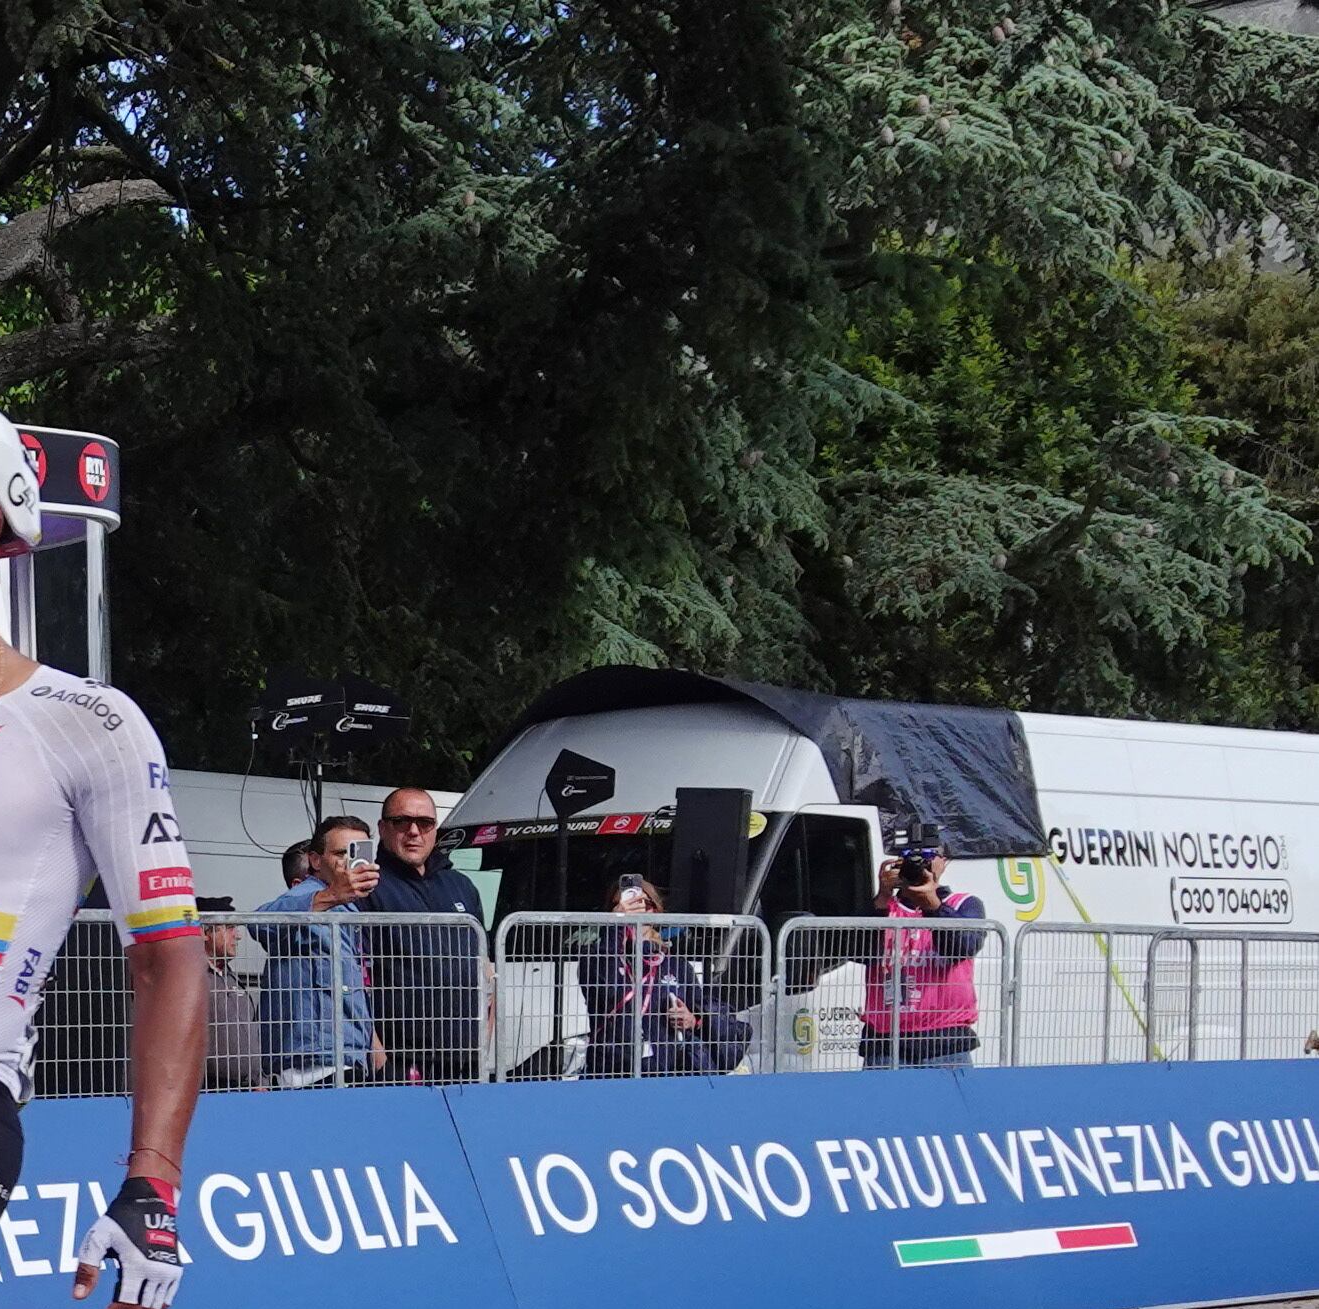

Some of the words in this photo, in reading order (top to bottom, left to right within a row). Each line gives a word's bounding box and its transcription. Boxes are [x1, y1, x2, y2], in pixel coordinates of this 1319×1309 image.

[85, 455, 105, 476] RTL
[49, 688, 124, 731] Analog
[1048, 826, 1159, 868] GUERRINI
[1161, 831, 1281, 871] NOLEGGIO
[1179, 887, 1215, 914] 030
[1217, 887, 1290, 915] 7040439
[508, 1152, 599, 1237] IO
[608, 1141, 812, 1230] SONO
[814, 1134, 986, 1214] FRIULI
[977, 1121, 1212, 1203] VENEZIA
[1208, 1118, 1319, 1188] GIUL
[199, 1160, 459, 1262] GIULIA
